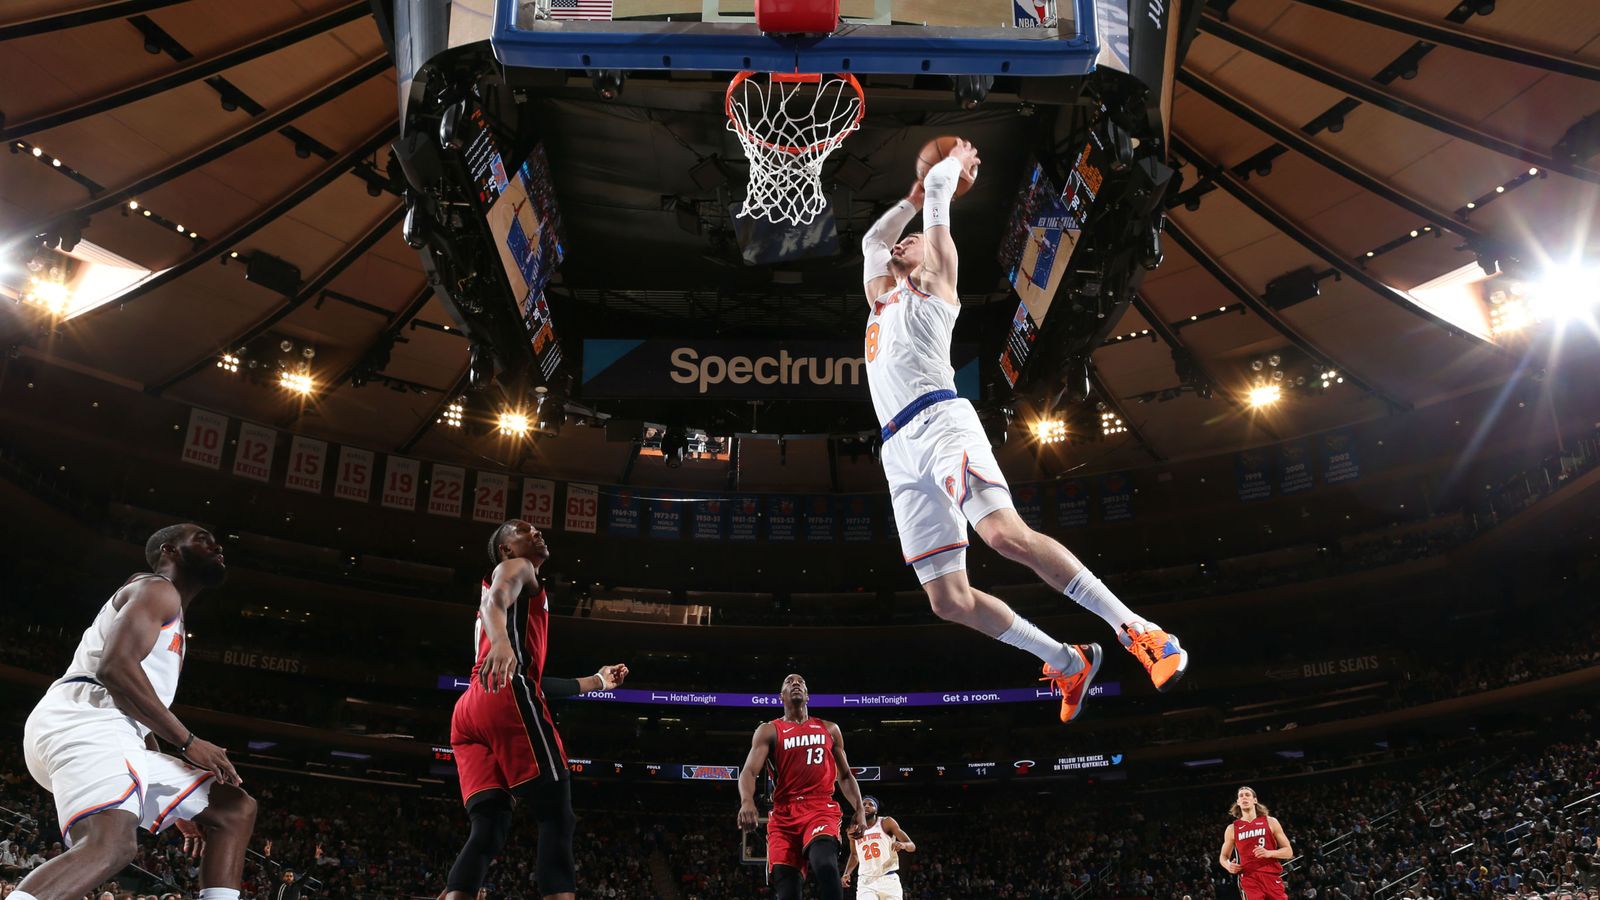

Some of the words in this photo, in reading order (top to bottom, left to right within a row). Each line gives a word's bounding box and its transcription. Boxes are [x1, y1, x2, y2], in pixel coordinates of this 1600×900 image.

[1018, 18, 1034, 28] NBA
[1072, 195, 1081, 211] 90
[866, 322, 880, 363] 8
[670, 347, 866, 393] Spectrum
[192, 425, 219, 450] 10
[242, 439, 268, 464] 12
[294, 452, 320, 475] 15
[343, 462, 367, 484] 15
[390, 471, 413, 493] 19
[432, 479, 461, 502] 22
[477, 486, 505, 508] 24
[524, 492, 551, 513] 33
[567, 496, 597, 517] 613
[223, 650, 257, 668] BLUE
[260, 655, 300, 673] SEATS
[1303, 661, 1337, 677] BLUE
[1338, 655, 1379, 673] SEATS
[587, 690, 616, 700] room.
[751, 696, 769, 704] Get
[943, 694, 960, 702] Get
[971, 693, 1000, 702] room.
[783, 733, 826, 750] MIAMI
[806, 747, 824, 765] 13
[1061, 762, 1080, 770] TWITTER
[1081, 760, 1109, 768] @NYKNICKS
[1086, 754, 1103, 762] KNICKS
[976, 768, 987, 776] 11
[1237, 827, 1266, 841] MIAMI
[862, 842, 881, 861] 26
